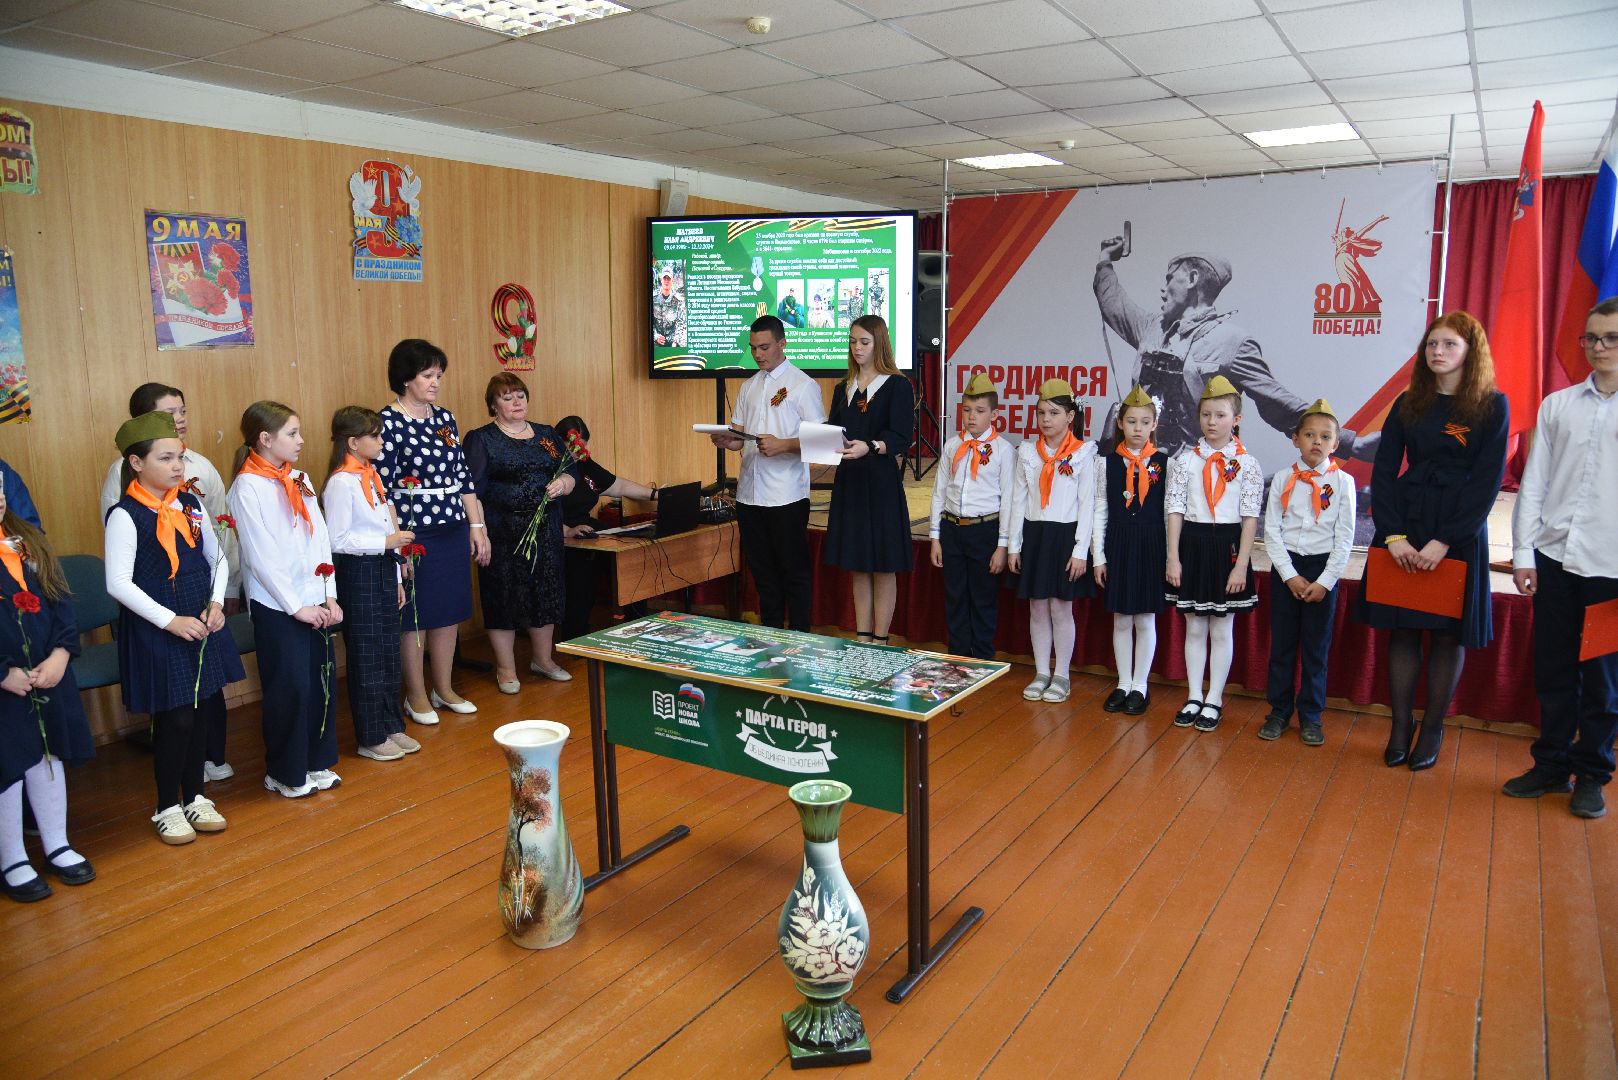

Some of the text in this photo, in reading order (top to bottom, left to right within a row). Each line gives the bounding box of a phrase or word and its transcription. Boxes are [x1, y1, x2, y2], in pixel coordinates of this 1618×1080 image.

[0, 158, 33, 186] Ы!
[355, 216, 382, 228] МАЯ
[153, 216, 242, 242] 9 МАЯ
[356, 259, 421, 270] С ПРАЗДНИКОМ
[355, 270, 389, 279] ВЕЛИКОЙ
[1314, 283, 1351, 313] 80
[1312, 319, 1382, 336] ПОБЕДА!
[678, 701, 699, 710] ПРОЕКТ
[678, 709, 698, 718] НОВАЯ
[679, 717, 700, 728] ШКОЛА
[745, 708, 827, 740] ПАРТА ГЕРОЯ
